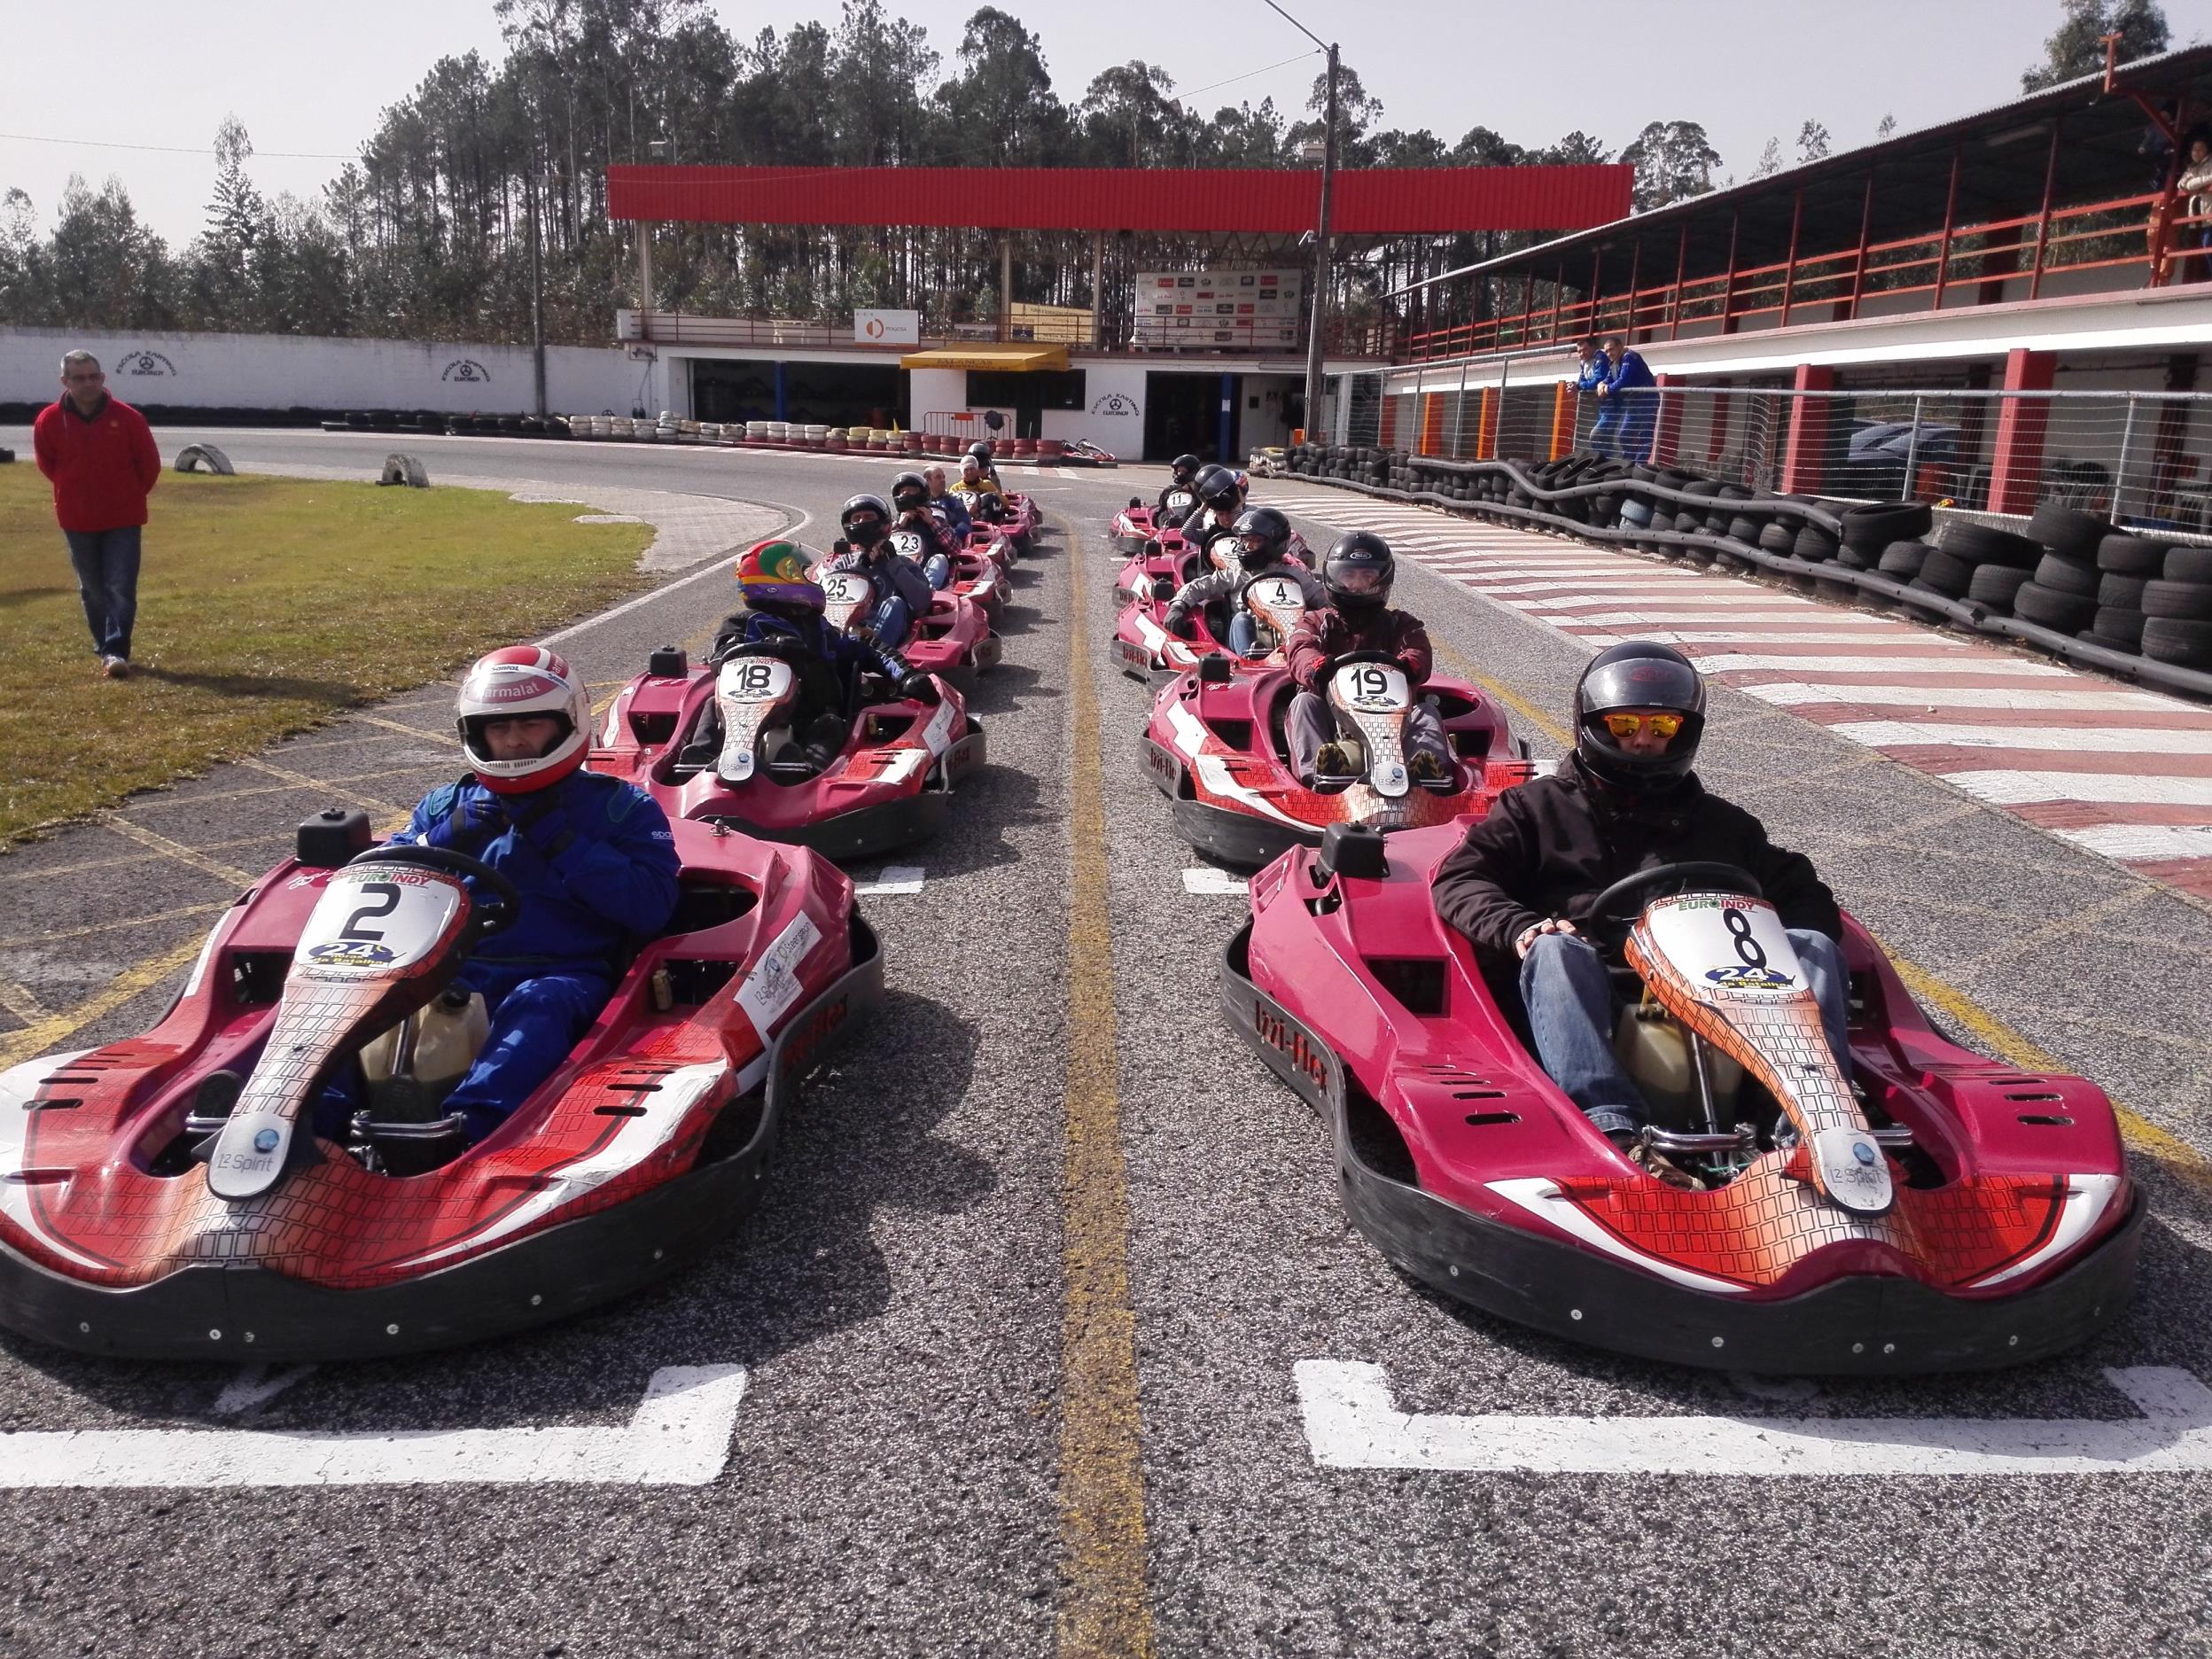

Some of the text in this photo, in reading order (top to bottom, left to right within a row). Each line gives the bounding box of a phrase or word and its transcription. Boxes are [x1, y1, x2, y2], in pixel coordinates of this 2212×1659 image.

[1091, 393, 1140, 417] ESCOLA KARTING
[900, 535, 919, 551] 23
[826, 579, 847, 598] 25
[1276, 582, 1287, 603] 4
[736, 664, 772, 691] 18
[1351, 669, 1388, 697] 19
[479, 682, 541, 698] armalat
[339, 883, 401, 941] 2
[1723, 908, 1767, 969] 8
[318, 943, 375, 958] 24
[1716, 968, 1770, 980] 24
[232, 1155, 275, 1176] Spirit
